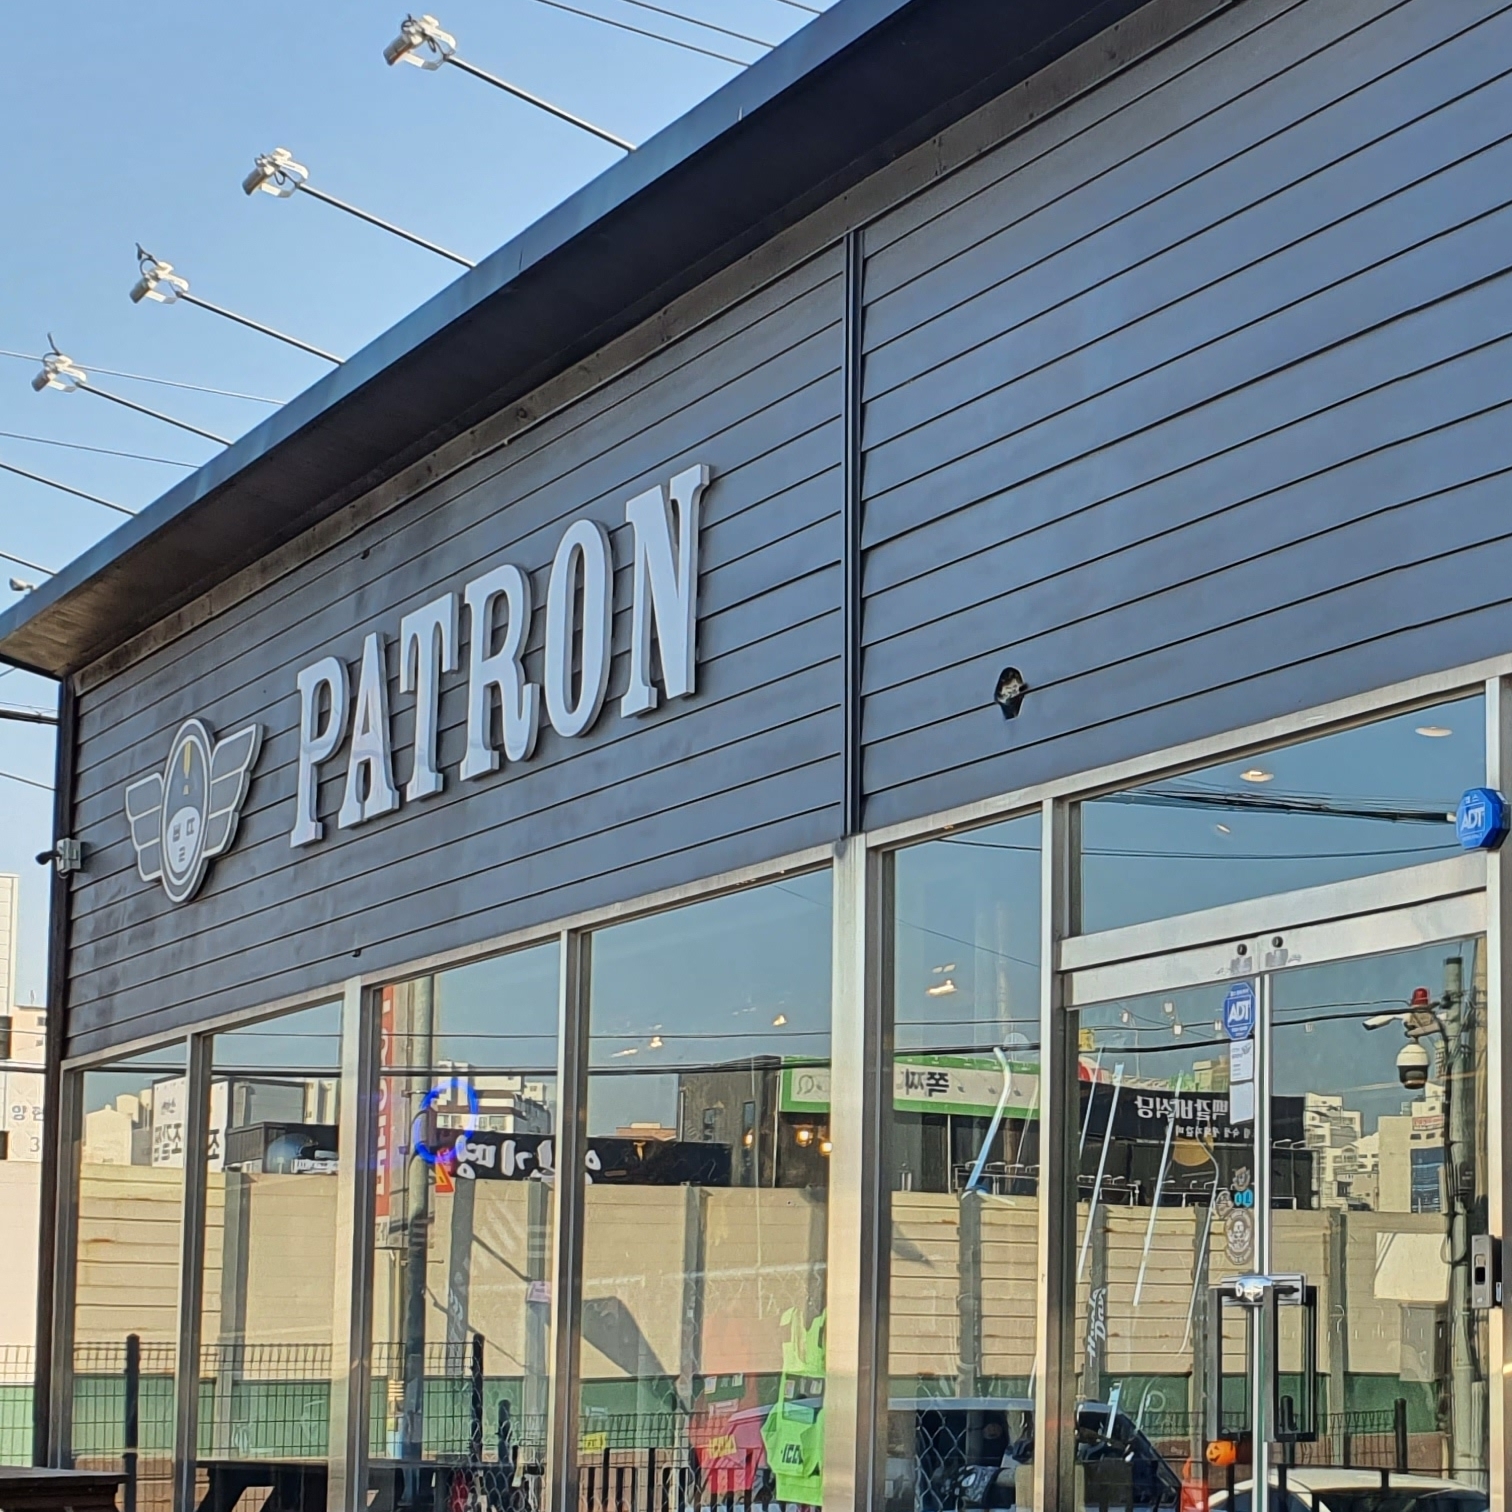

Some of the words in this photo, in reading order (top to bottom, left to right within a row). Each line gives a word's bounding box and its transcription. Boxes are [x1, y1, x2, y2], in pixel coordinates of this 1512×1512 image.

[290, 463, 711, 849] PATRON
[1460, 807, 1485, 831] ADT
[1228, 1000, 1251, 1023] ADT
